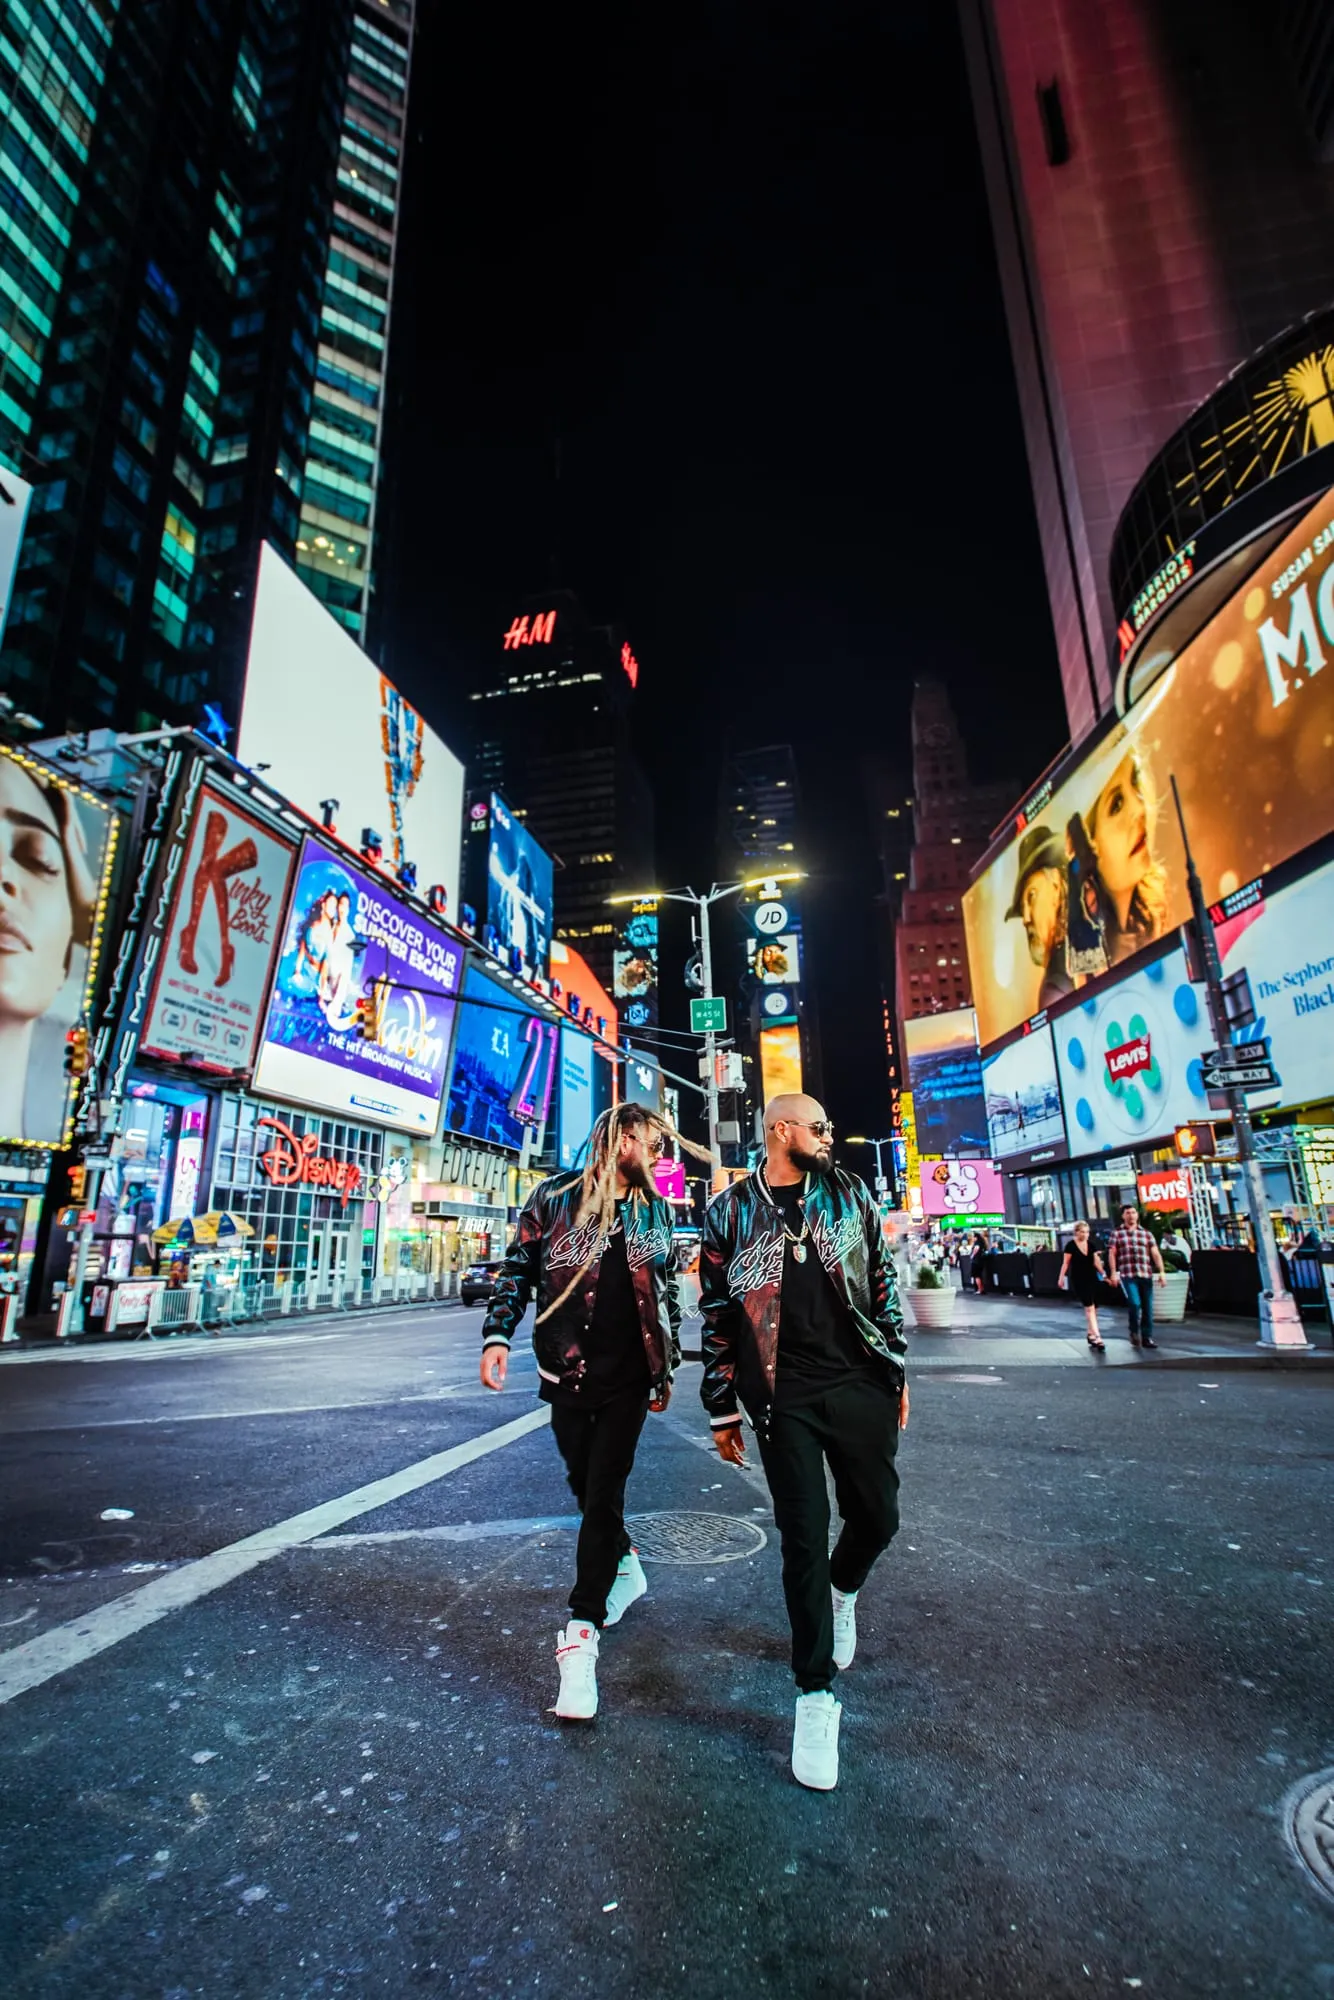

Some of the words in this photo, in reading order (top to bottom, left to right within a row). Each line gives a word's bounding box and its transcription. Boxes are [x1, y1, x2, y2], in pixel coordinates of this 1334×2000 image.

[1271, 548, 1313, 599] SUSAN
[504, 610, 557, 650] H&M
[357, 892, 423, 950] DISCOVER
[426, 938, 457, 973] YOUR
[761, 910, 782, 926] JD
[1256, 979, 1281, 999] The
[1281, 958, 1334, 989] Sephor
[1211, 1072, 1233, 1082] ONE
[1243, 1070, 1265, 1079] WAY
[440, 1143, 508, 1193] FOREVER
